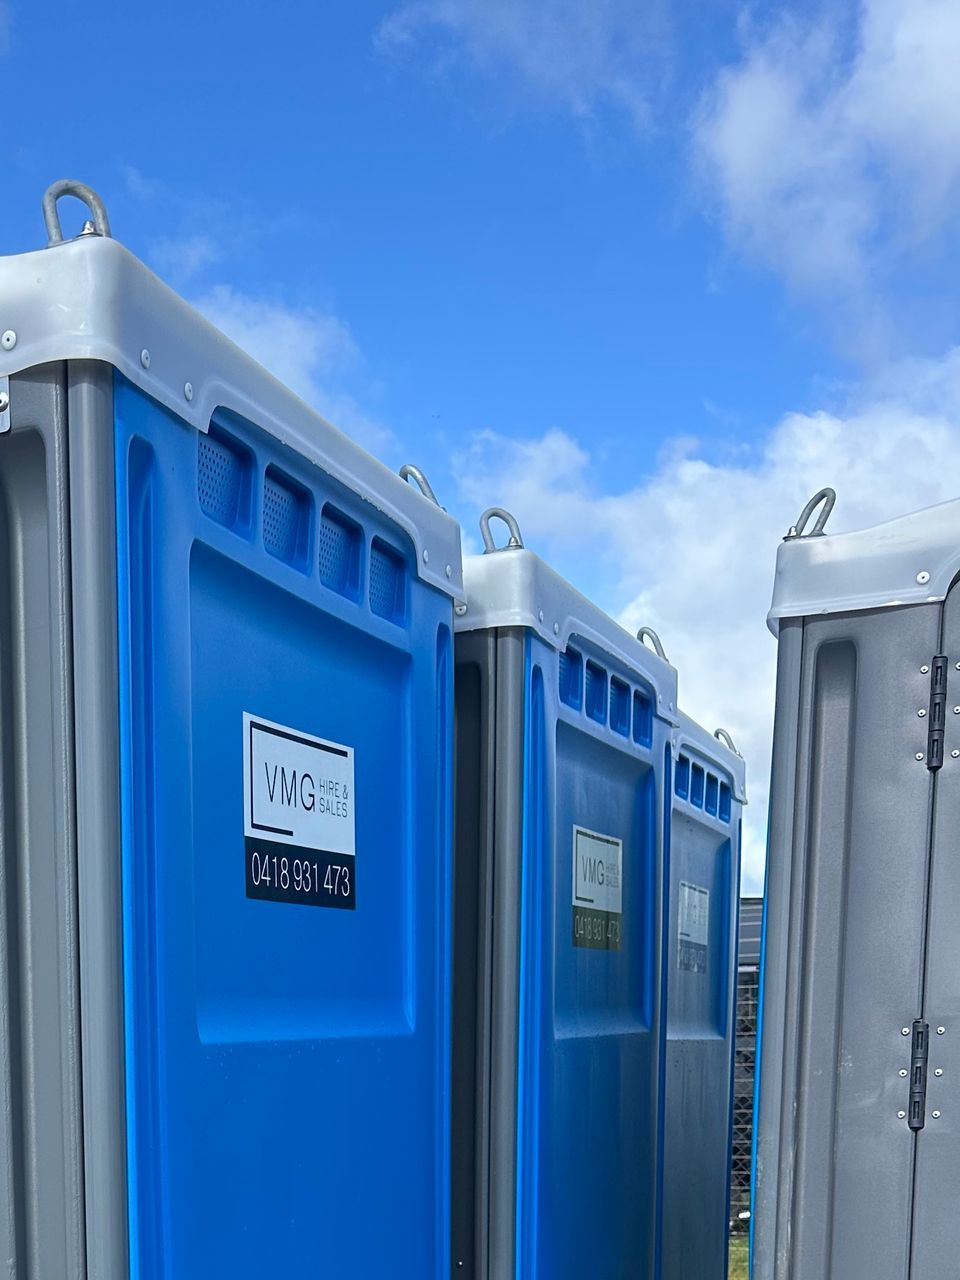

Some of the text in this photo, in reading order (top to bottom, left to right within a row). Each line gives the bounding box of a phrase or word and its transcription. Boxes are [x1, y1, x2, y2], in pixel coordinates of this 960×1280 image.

[265, 762, 315, 812] VMG
[320, 778, 348, 798] HIRE &
[319, 798, 347, 818] SALES
[251, 852, 350, 897] 0418 931 473
[582, 856, 605, 885] VMG
